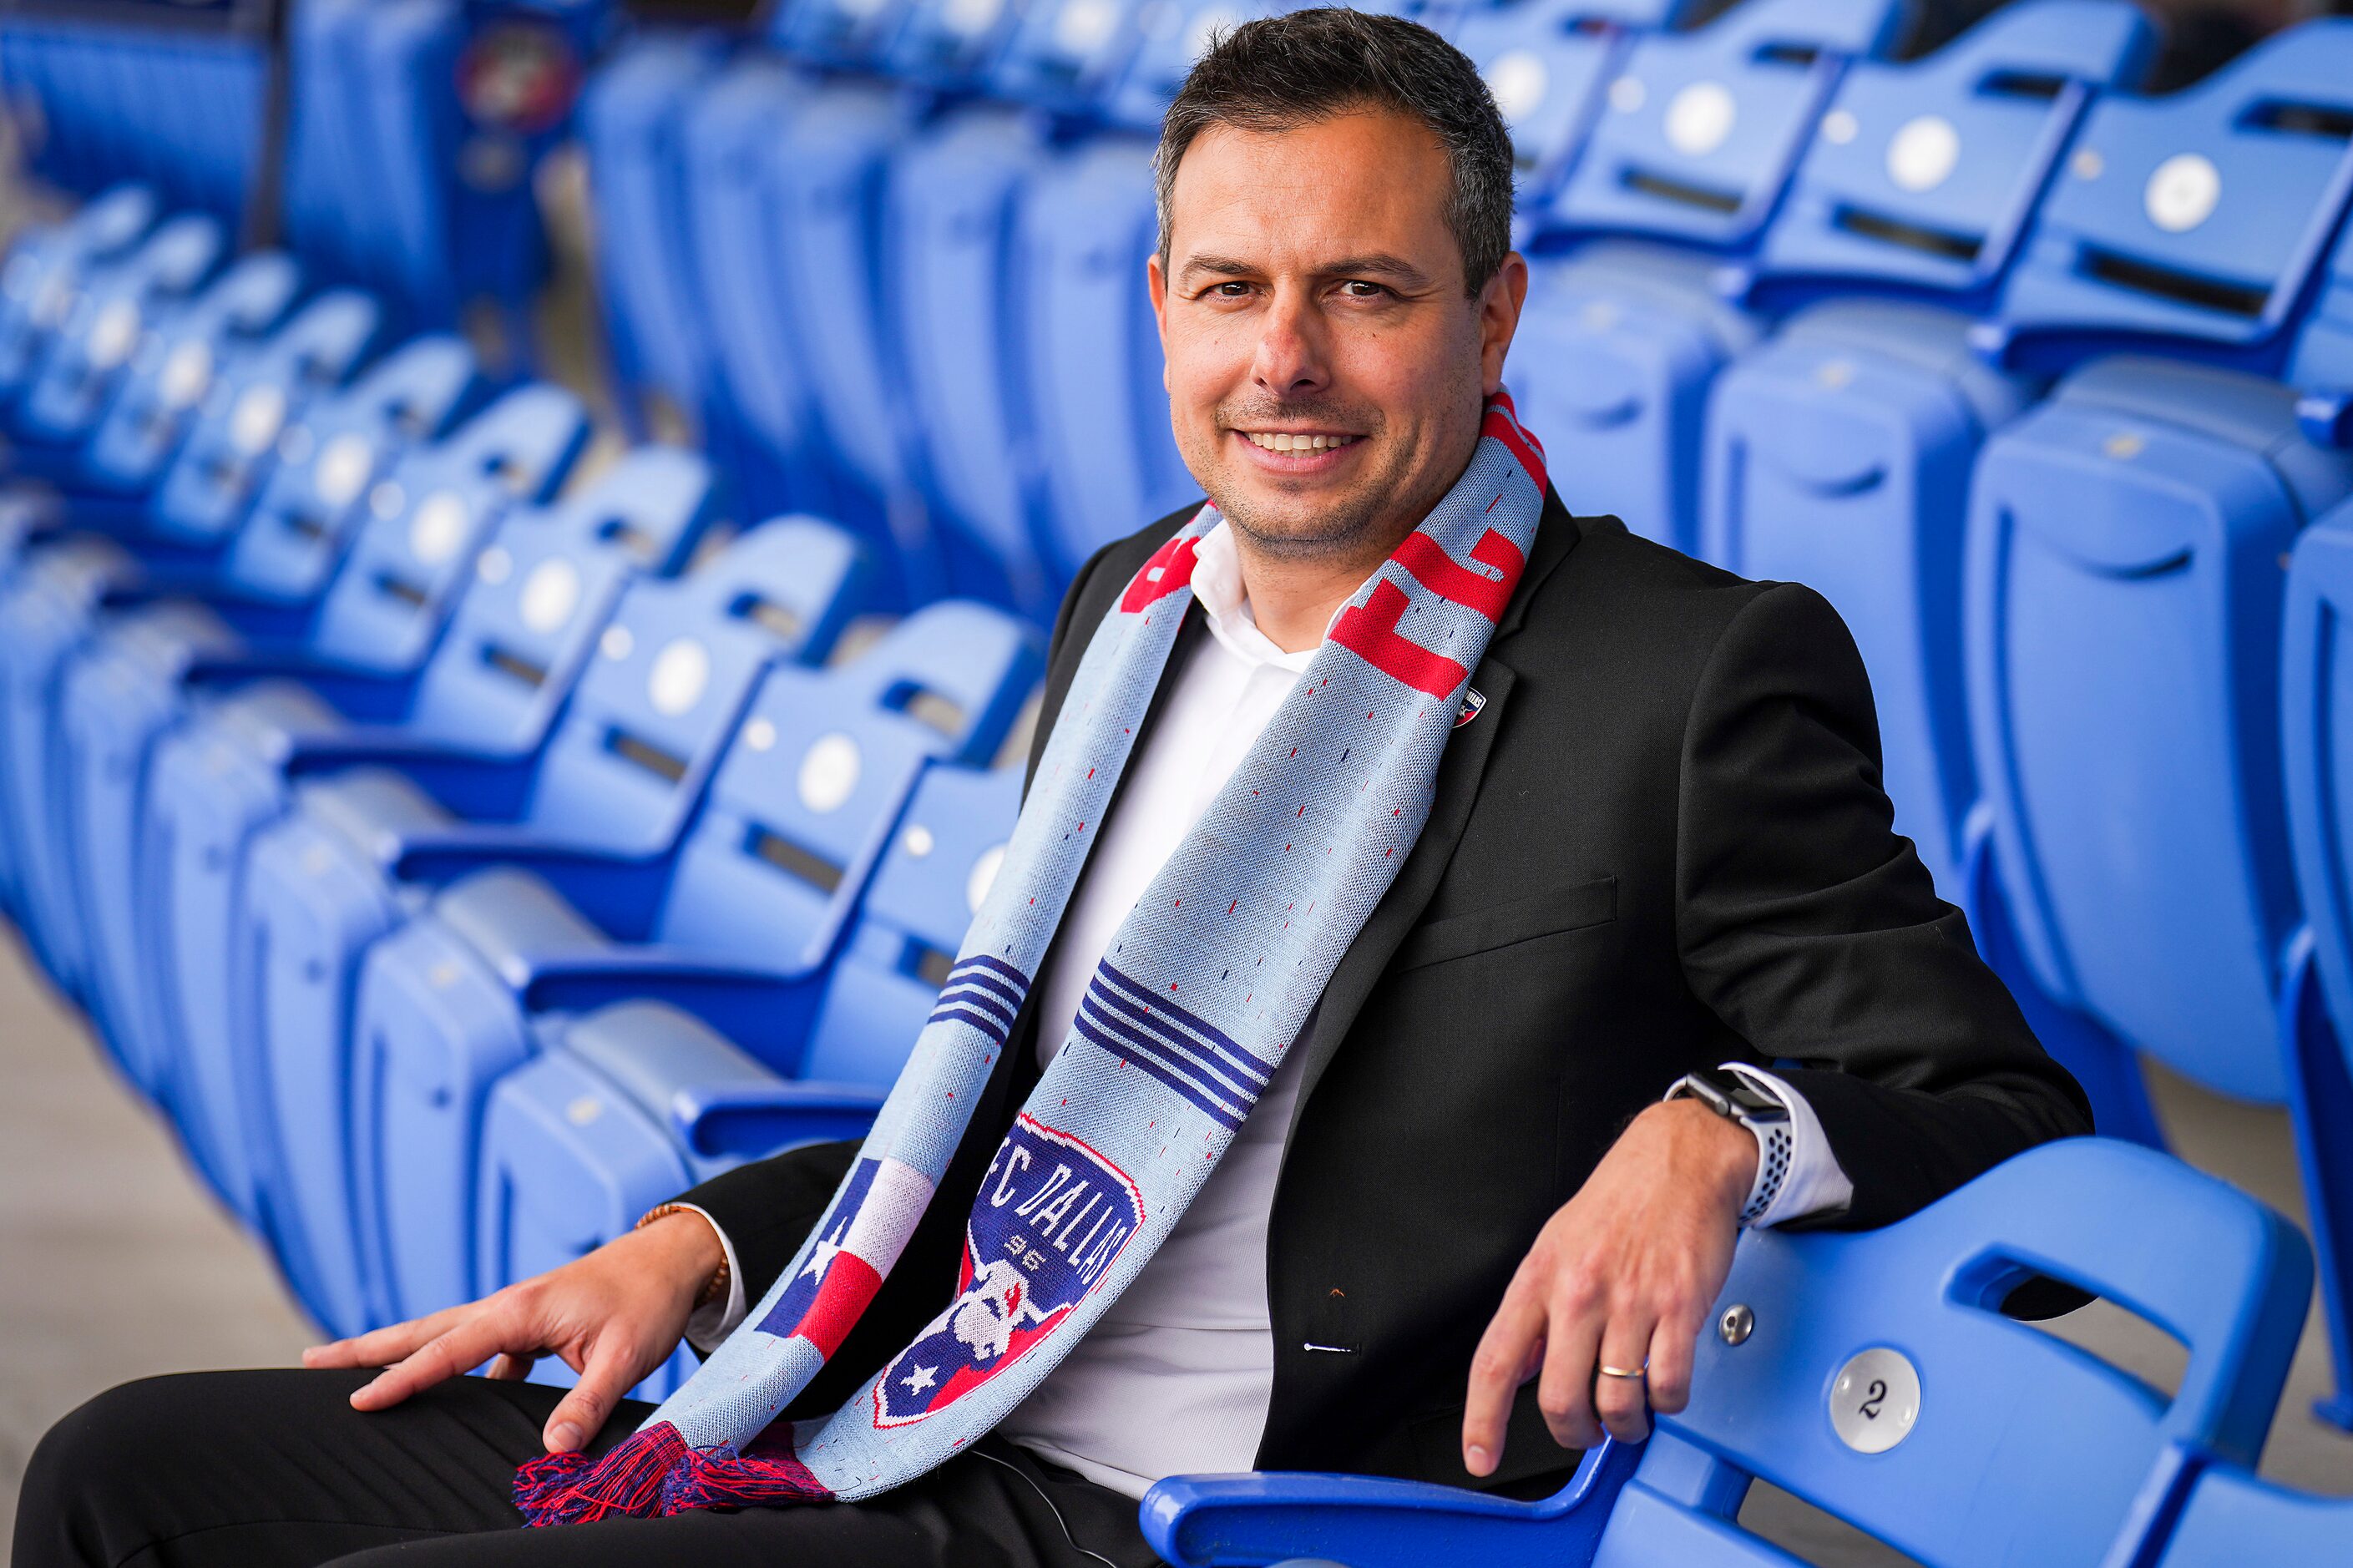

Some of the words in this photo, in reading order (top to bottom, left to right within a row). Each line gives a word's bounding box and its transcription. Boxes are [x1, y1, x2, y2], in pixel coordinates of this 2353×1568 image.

[1015, 1162, 1127, 1285] DALLAS
[1004, 1235, 1047, 1272] 96
[1859, 1379, 1888, 1420] 2
